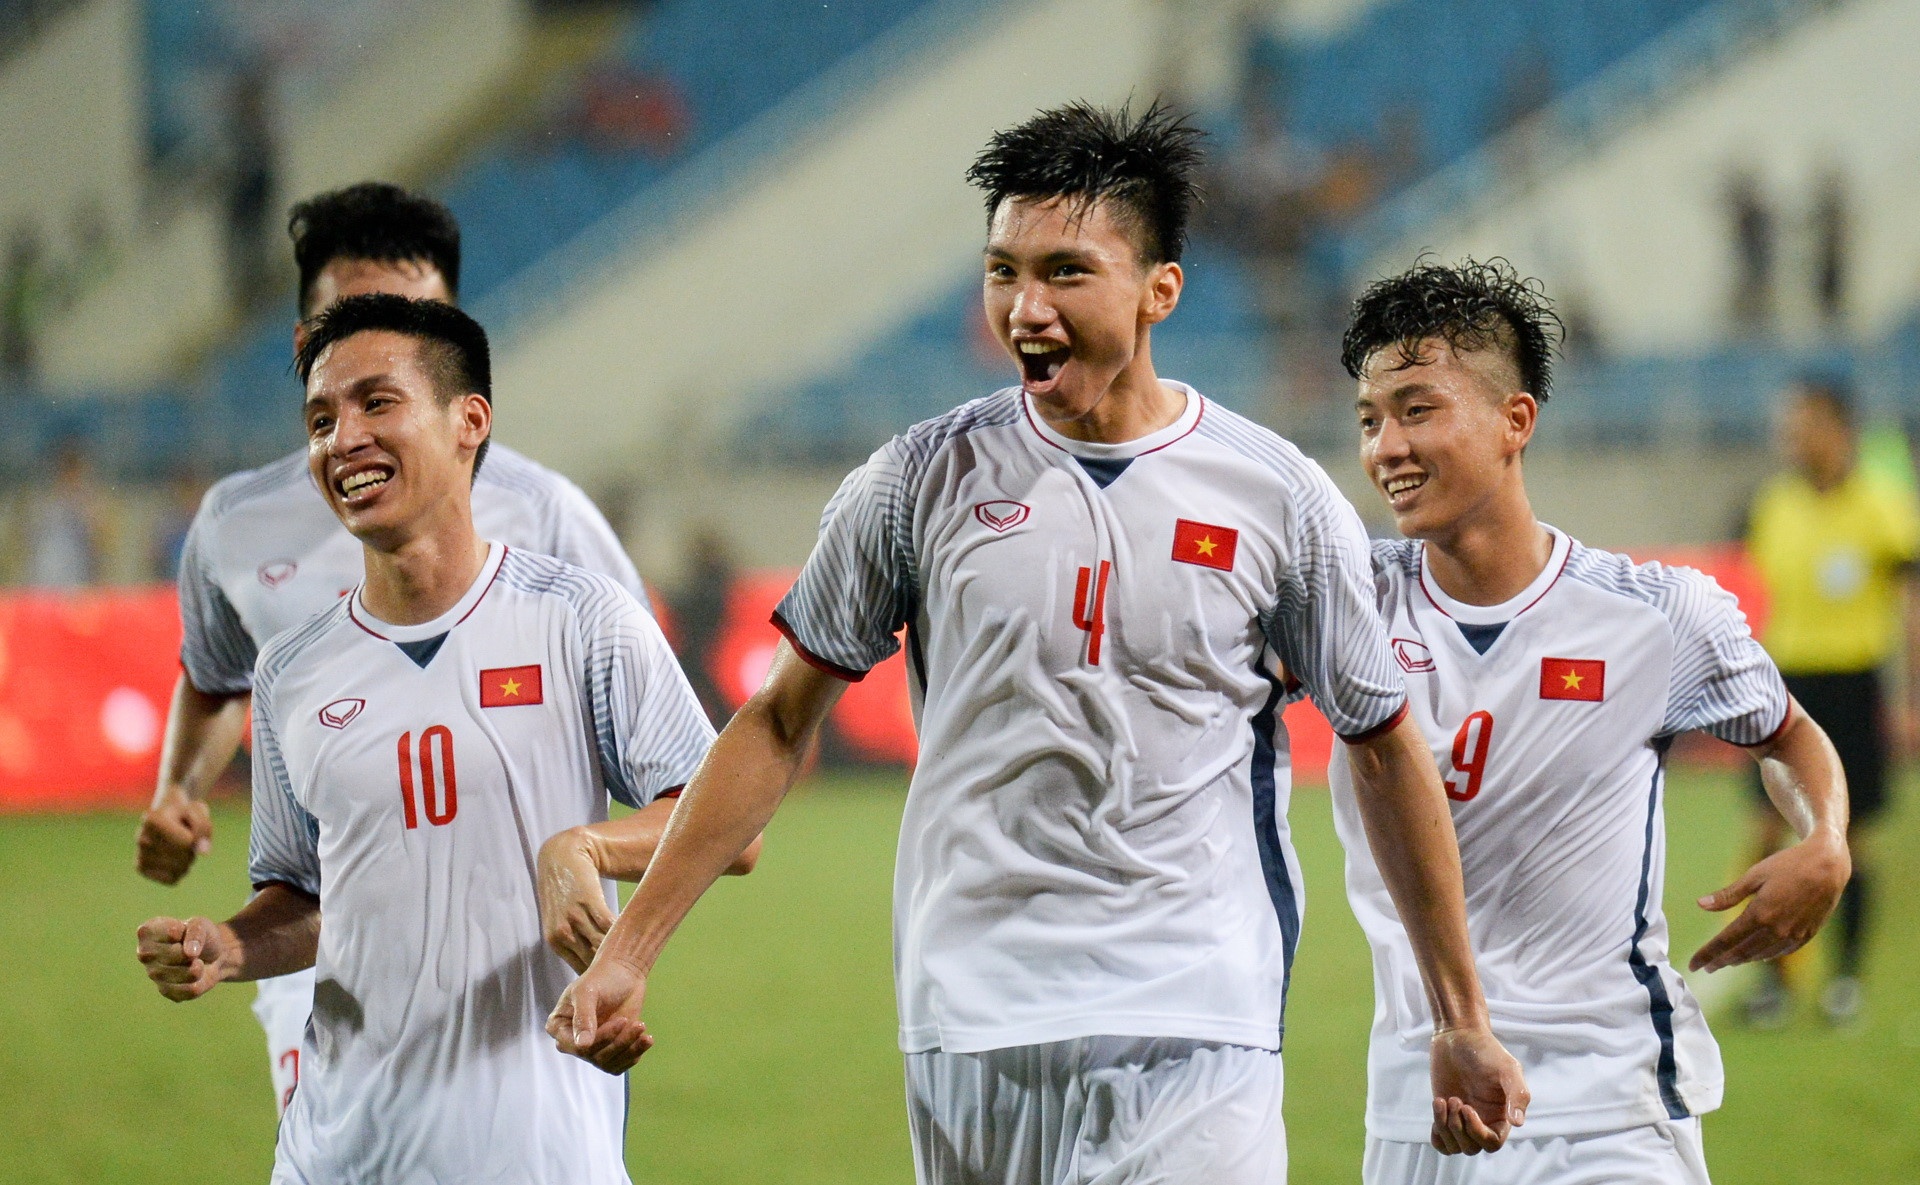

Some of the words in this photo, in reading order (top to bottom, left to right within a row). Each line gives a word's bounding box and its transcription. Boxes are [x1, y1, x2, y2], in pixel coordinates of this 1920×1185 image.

[1072, 560, 1111, 666] 4
[398, 725, 457, 830] 10
[1444, 710, 1494, 802] 9
